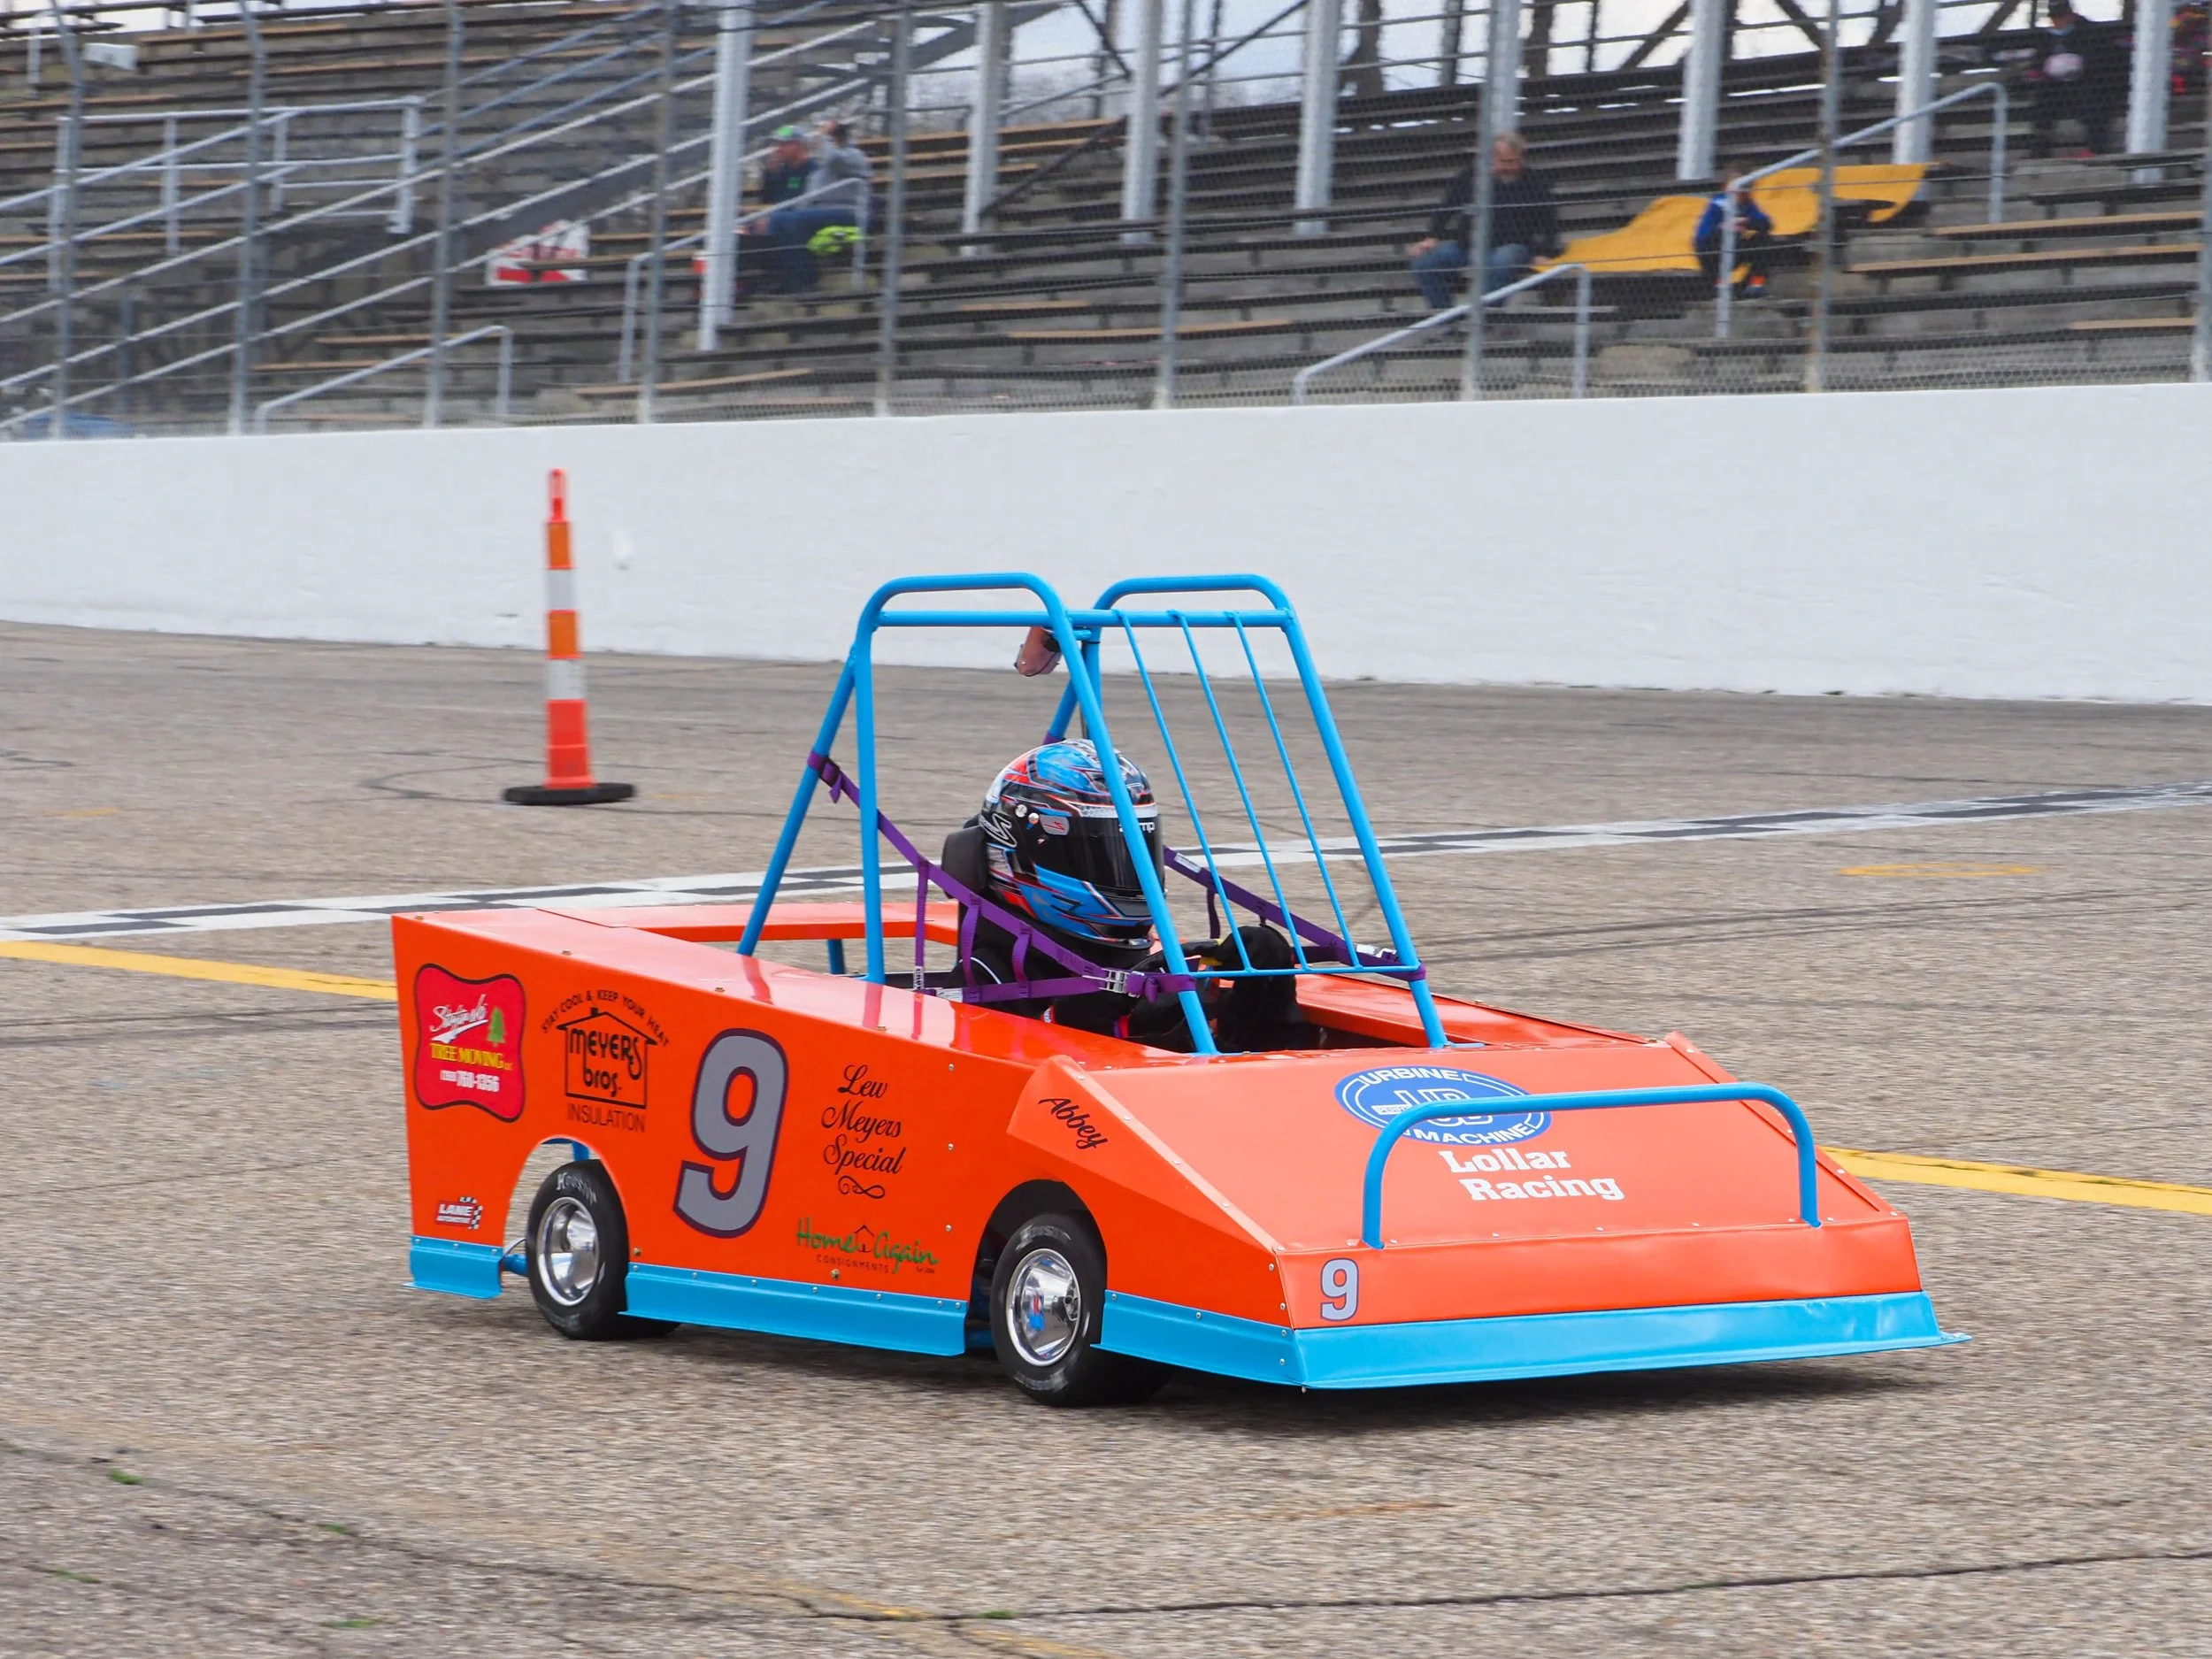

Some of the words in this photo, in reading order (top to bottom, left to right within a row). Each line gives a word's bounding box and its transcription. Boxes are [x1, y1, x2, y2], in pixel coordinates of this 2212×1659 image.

[560, 993, 584, 1013] COOL
[597, 989, 618, 1002] KEEP
[622, 995, 645, 1019] YOUR
[430, 1043, 457, 1062] TREE
[837, 1064, 888, 1099] Lew
[567, 1102, 645, 1133] INSULATION
[672, 1027, 789, 1239] 9
[821, 1100, 902, 1144] Meyers
[1038, 1098, 1109, 1149] Abbey
[1413, 1123, 1535, 1144] MACHINE
[823, 1133, 907, 1176] Special
[1439, 1148, 1571, 1173] Lollar
[1458, 1174, 1625, 1201] Racing
[439, 1203, 473, 1217] LANE
[796, 1217, 859, 1253] Home
[873, 1231, 940, 1275] Again
[816, 1253, 889, 1274] CONSIGNMENTS
[1320, 1257, 1360, 1321] 9
